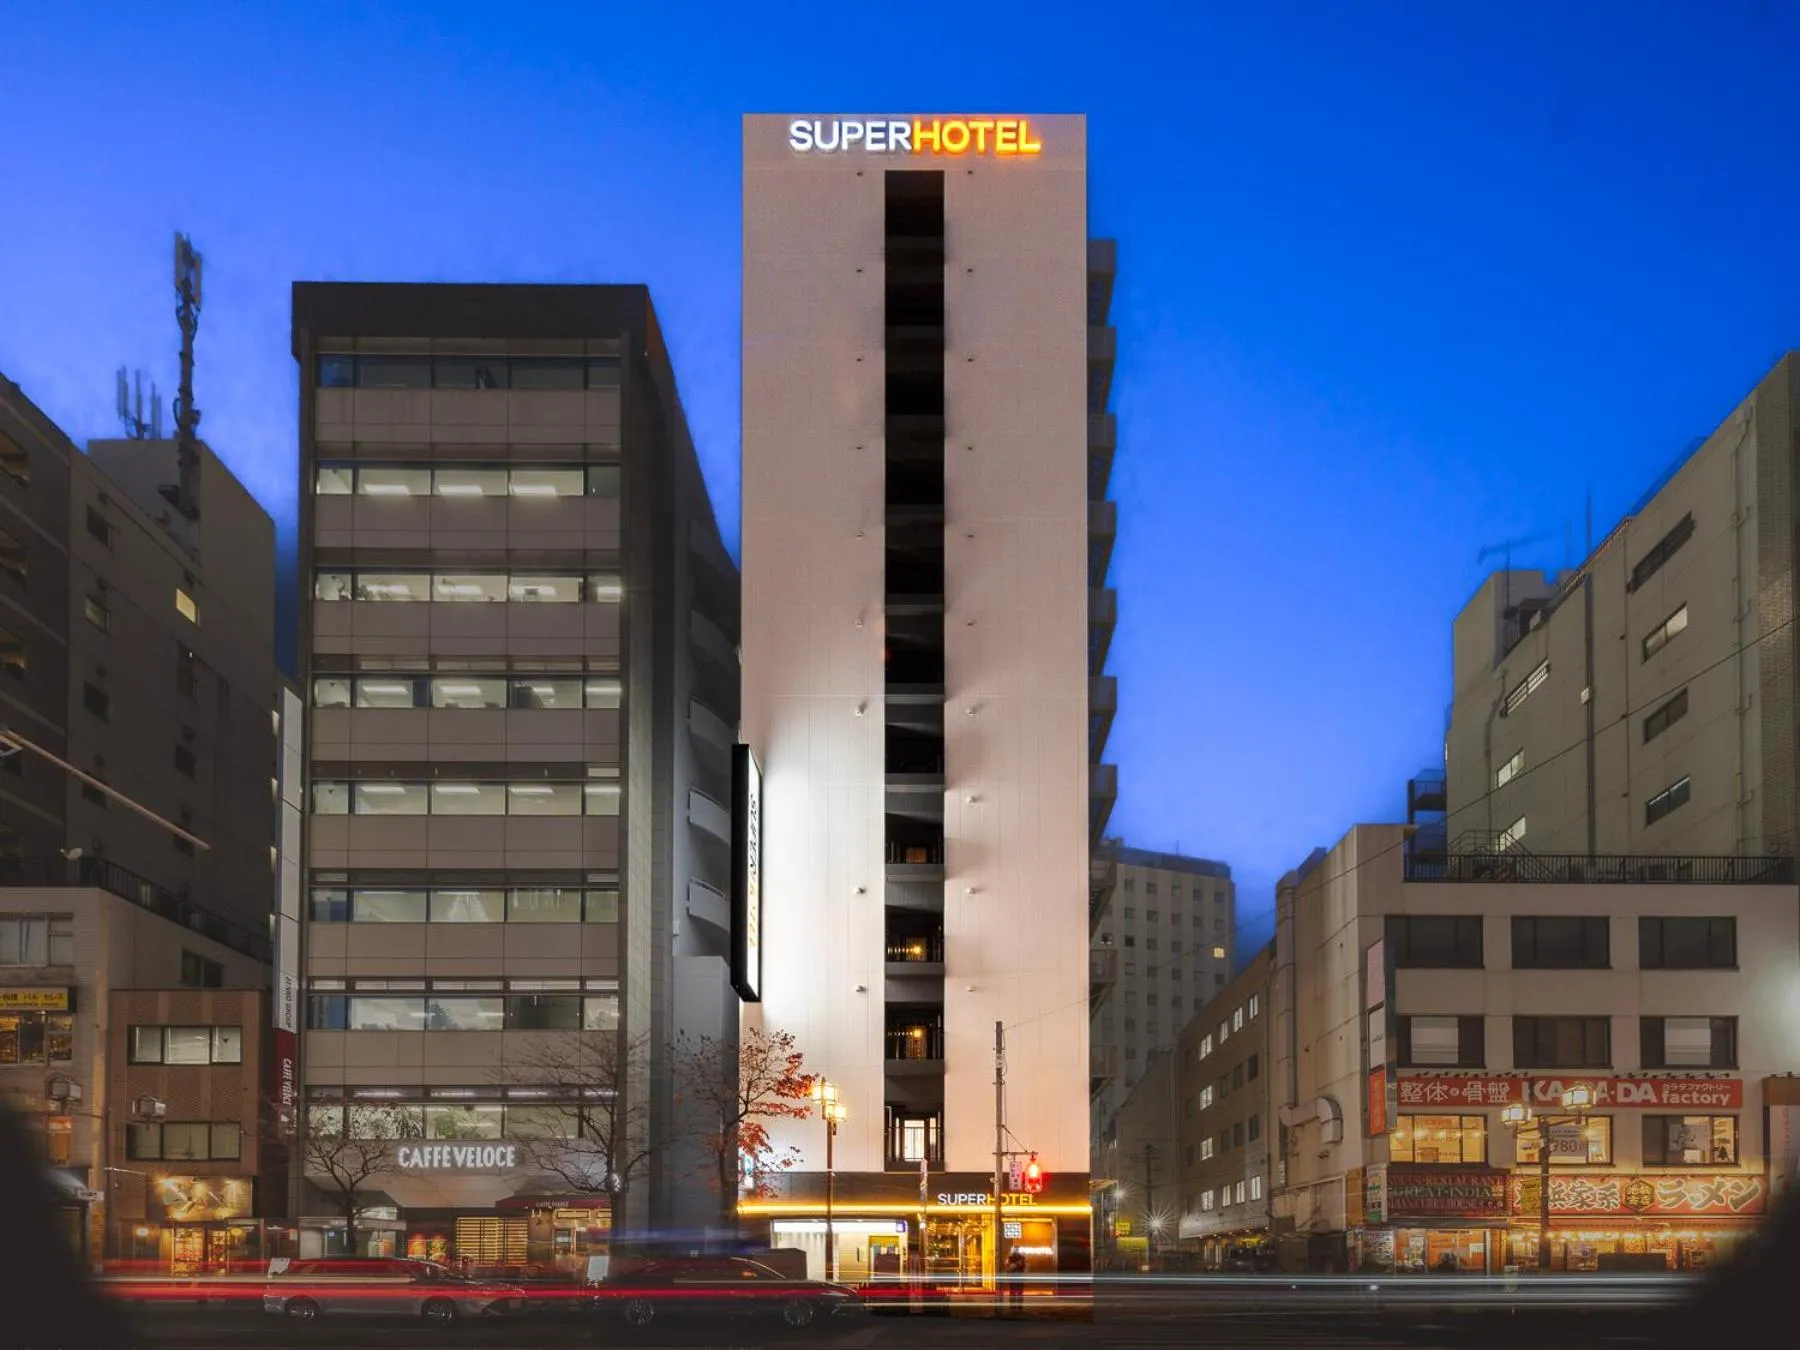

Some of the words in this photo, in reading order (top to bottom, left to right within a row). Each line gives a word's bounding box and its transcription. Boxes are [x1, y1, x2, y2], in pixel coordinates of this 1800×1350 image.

[789, 120, 1041, 151] SUPERHOTEL
[1662, 1089, 1731, 1106] factory
[452, 1145, 516, 1168] VELOCE
